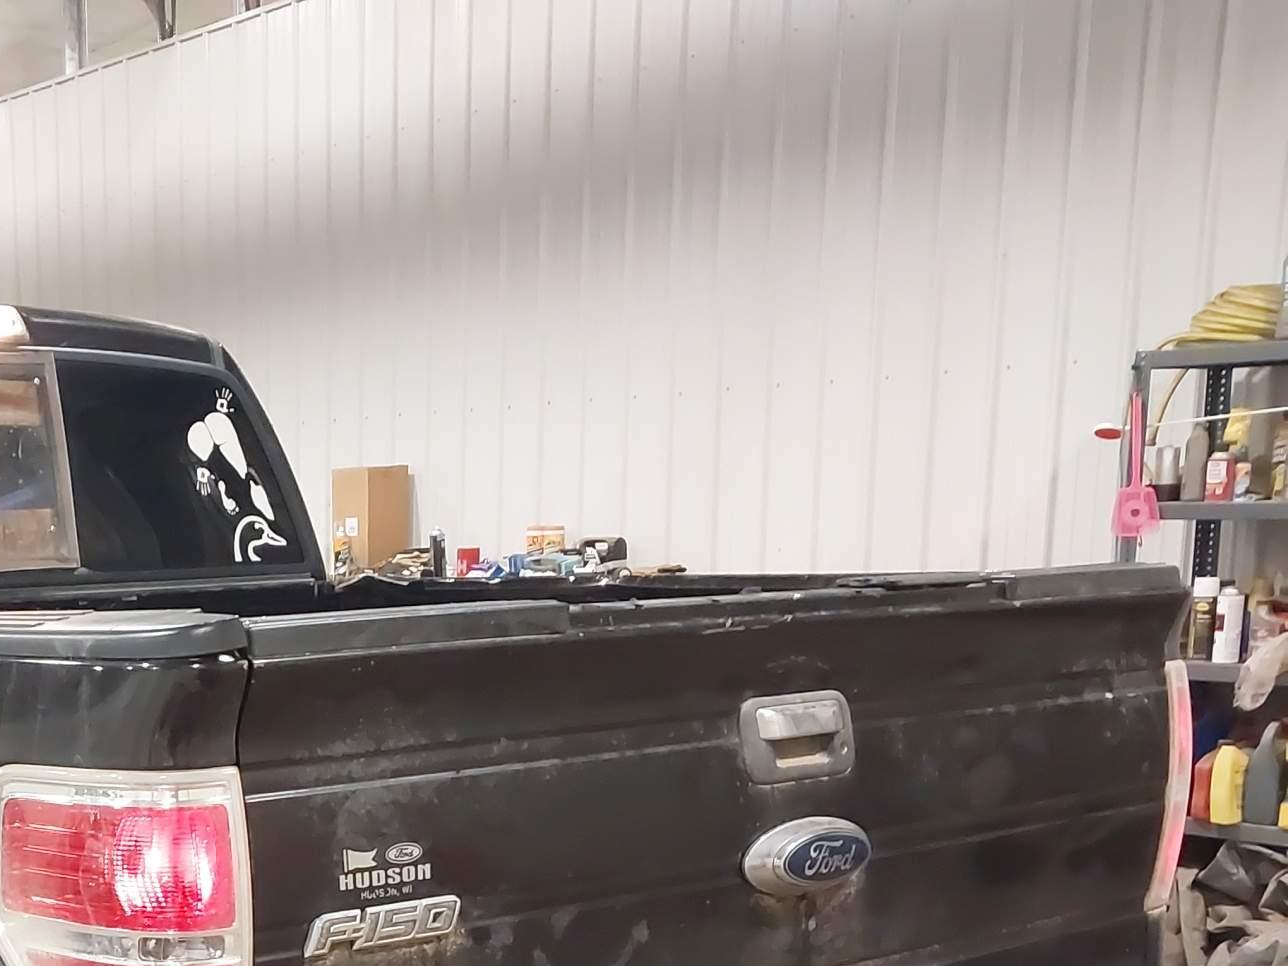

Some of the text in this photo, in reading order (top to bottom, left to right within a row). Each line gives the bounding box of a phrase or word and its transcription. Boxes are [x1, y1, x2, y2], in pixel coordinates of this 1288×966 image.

[804, 839, 856, 876] Ford
[339, 863, 432, 891] HUDSON
[304, 895, 461, 959] F-150
